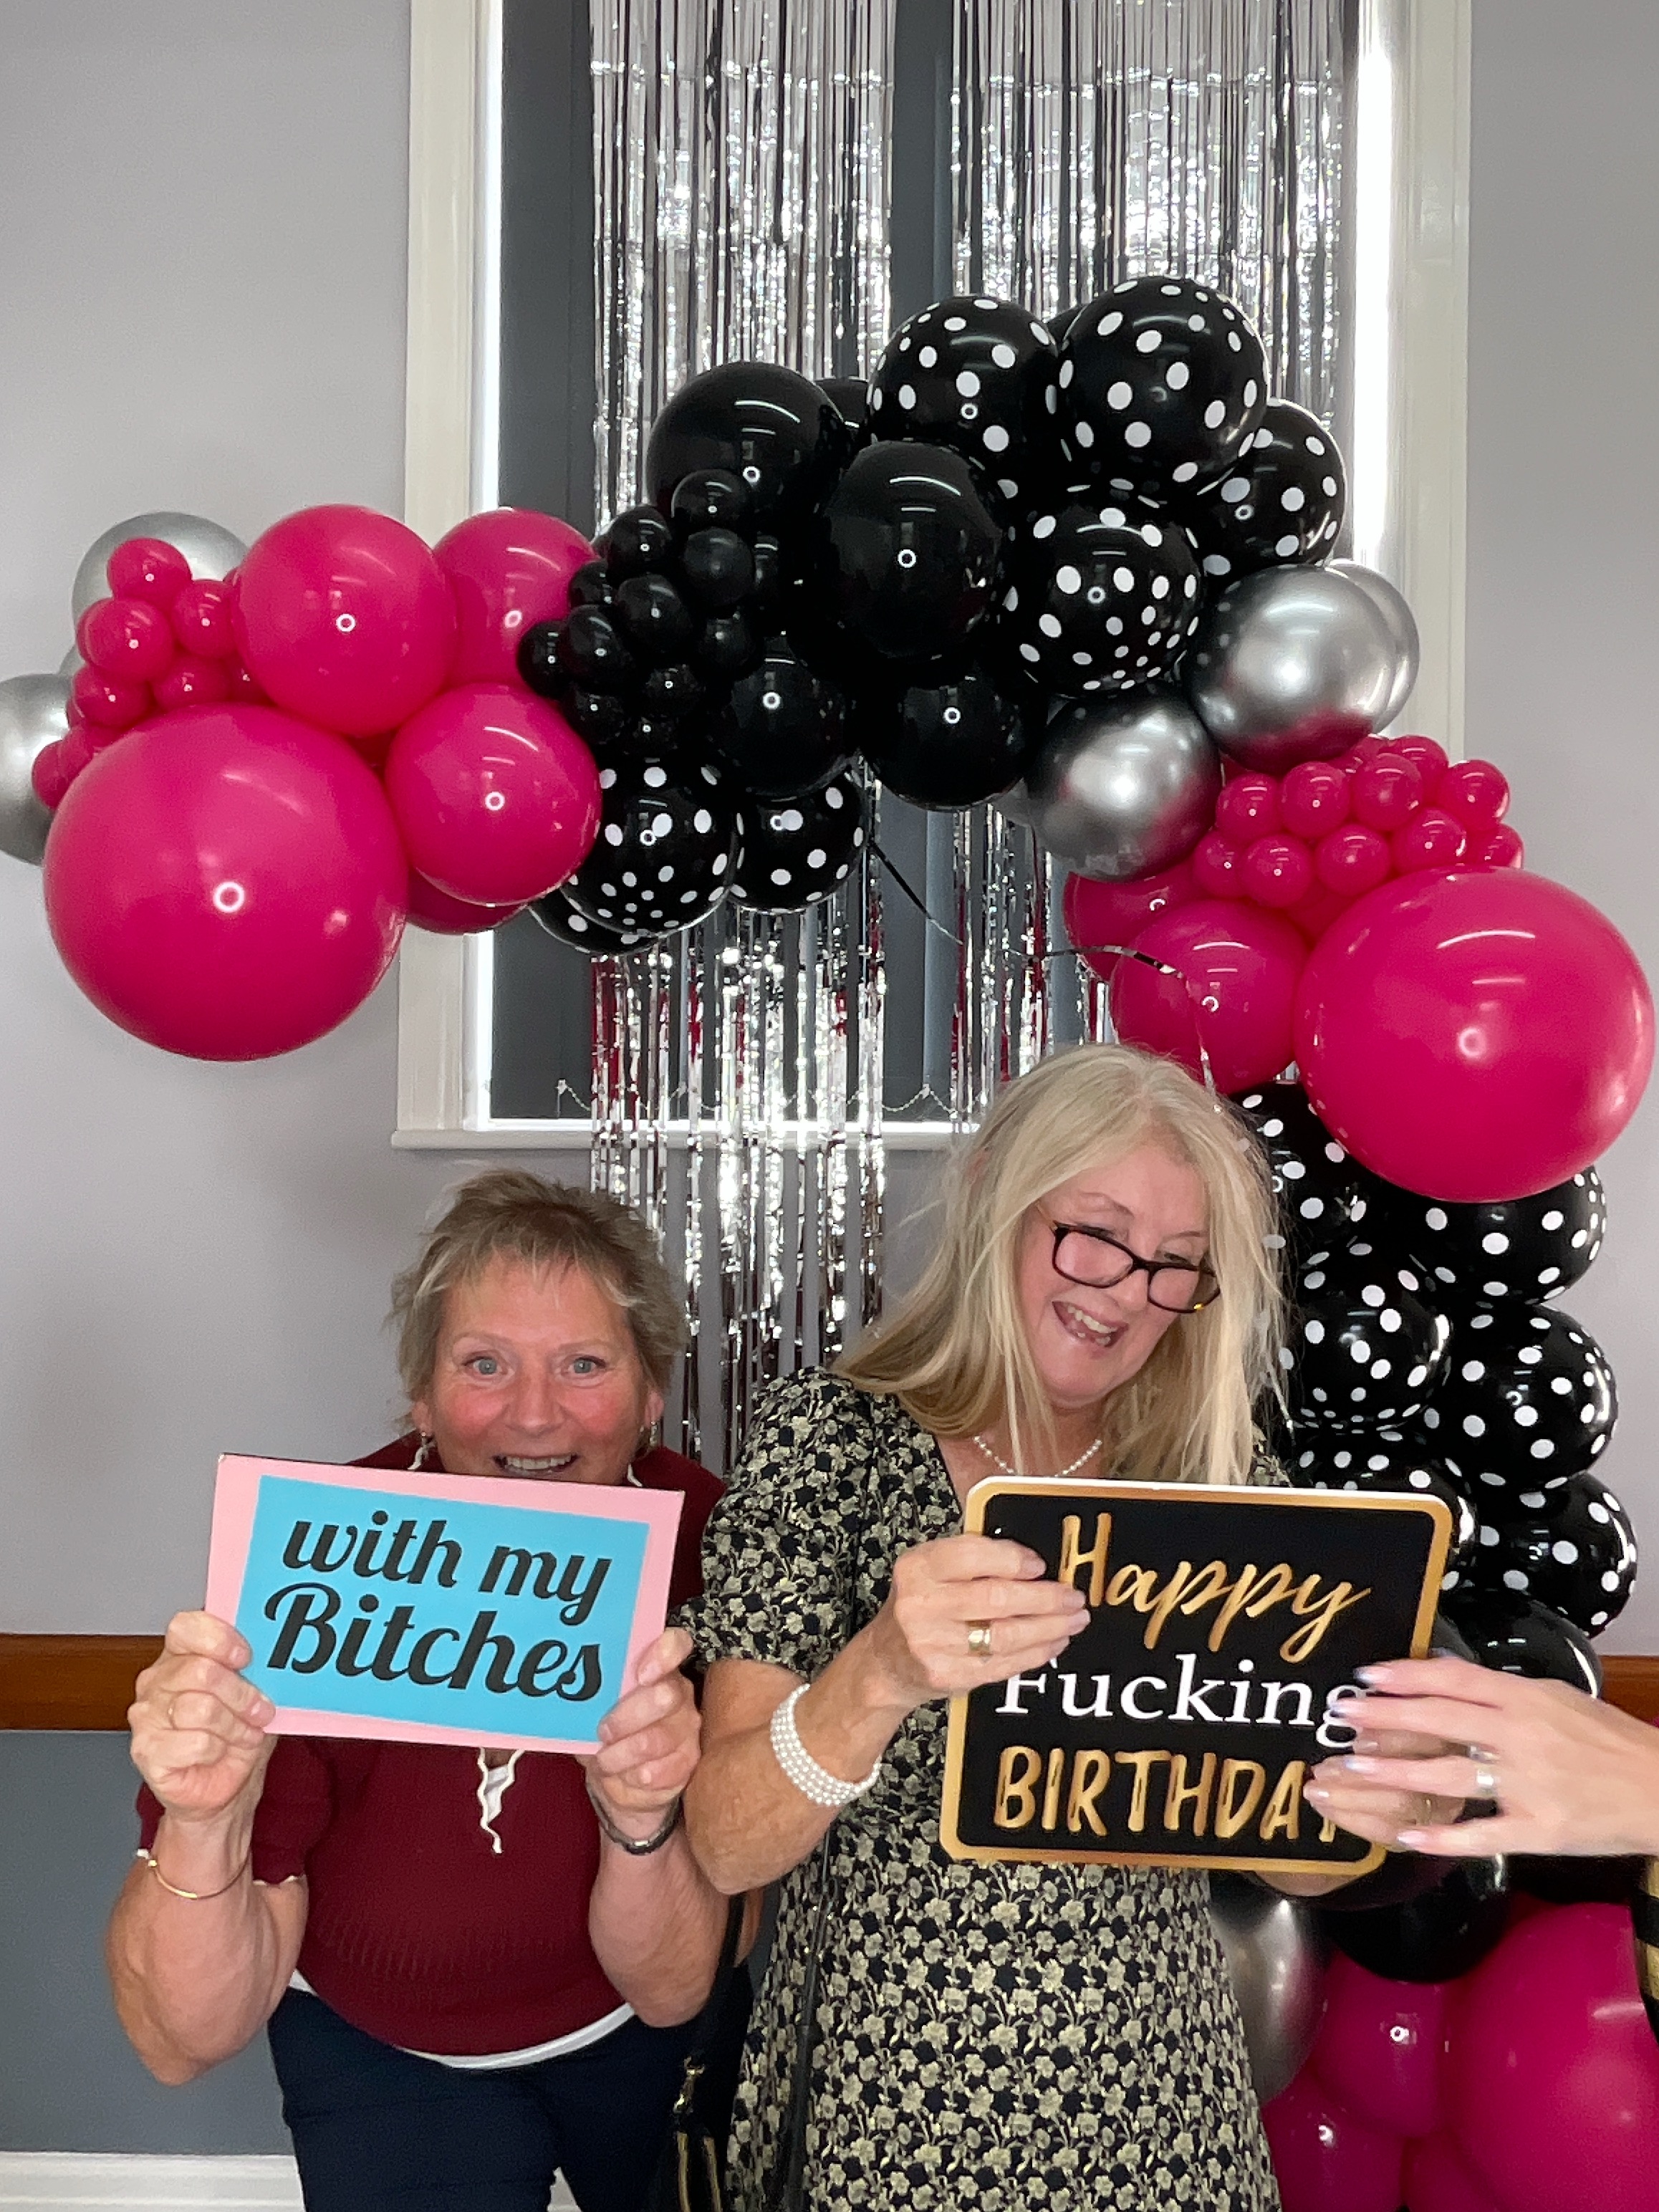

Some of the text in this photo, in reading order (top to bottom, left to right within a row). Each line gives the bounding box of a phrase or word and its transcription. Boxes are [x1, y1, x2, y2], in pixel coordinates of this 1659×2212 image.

[282, 1510, 612, 1626] with my
[1058, 1512, 1371, 1663] Happy
[264, 1582, 602, 1701] Bitches
[994, 1746, 1337, 1842] BIRTHDA
